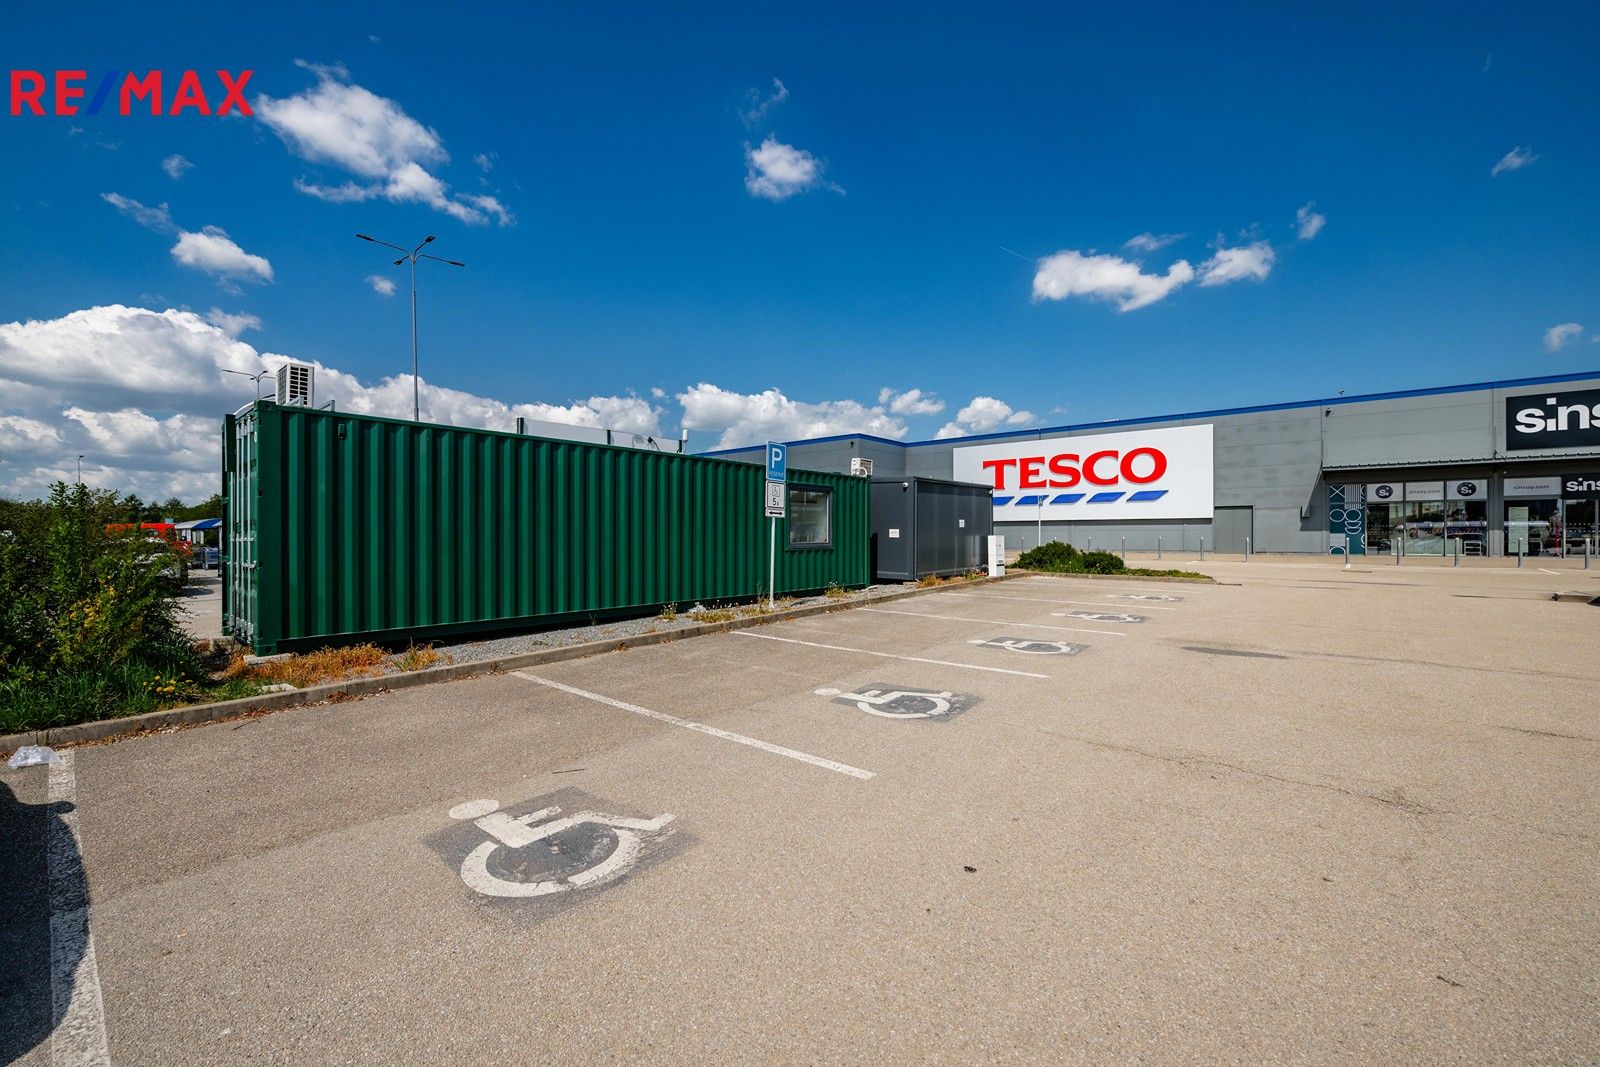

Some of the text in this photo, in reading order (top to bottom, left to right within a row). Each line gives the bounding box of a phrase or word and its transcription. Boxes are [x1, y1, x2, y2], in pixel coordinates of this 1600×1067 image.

[1515, 397, 1600, 434] sin
[772, 447, 782, 469] P
[982, 447, 1167, 490] TESCO
